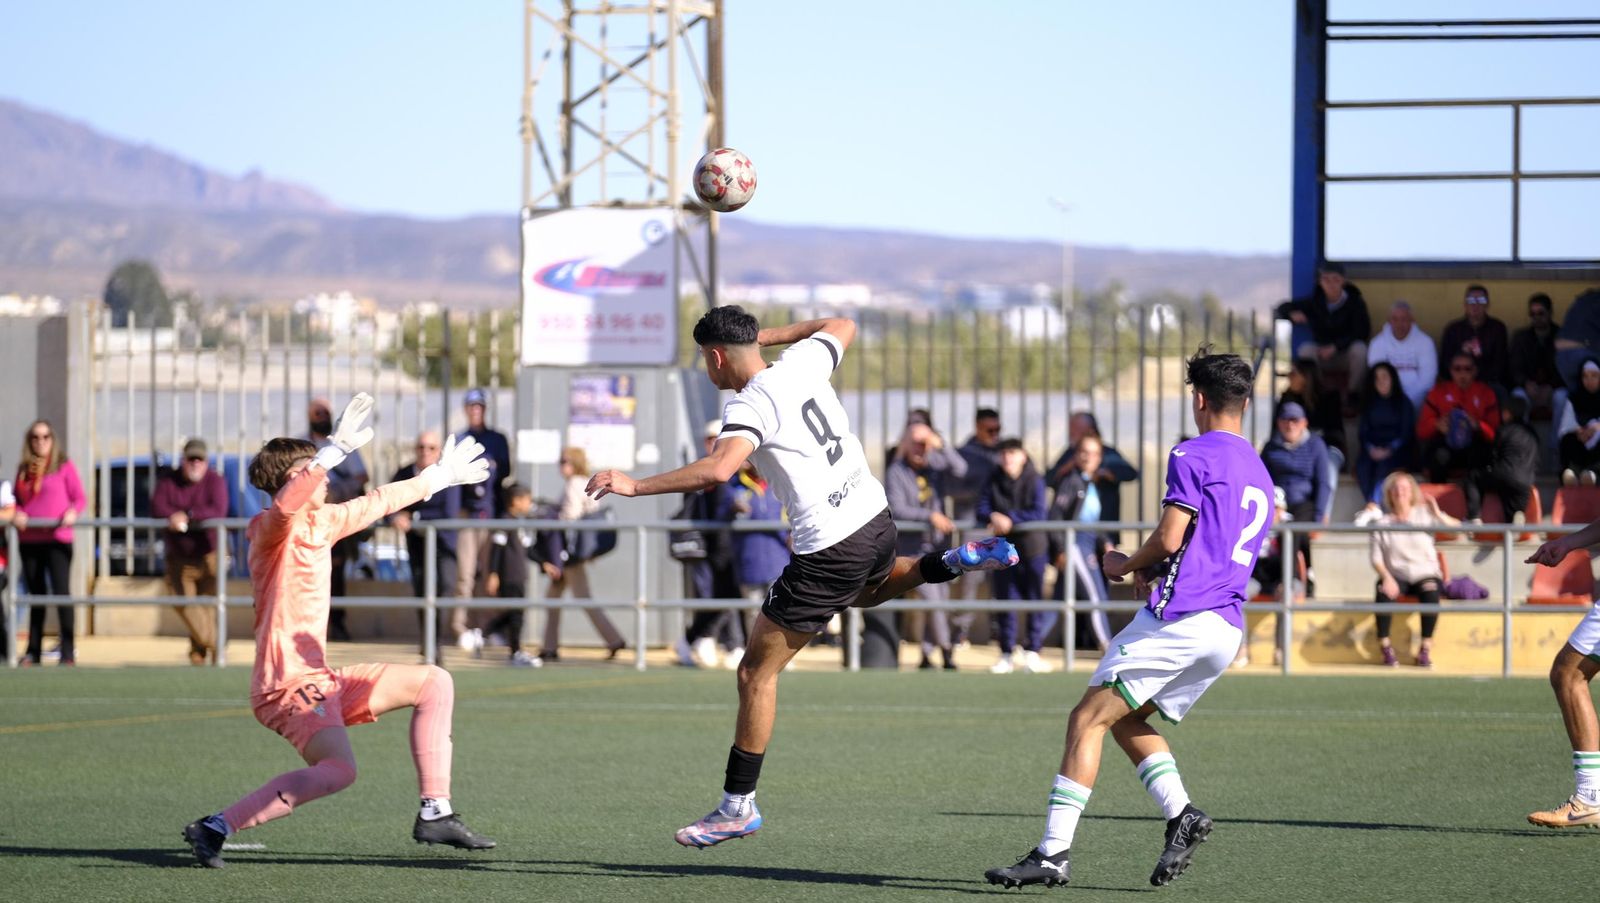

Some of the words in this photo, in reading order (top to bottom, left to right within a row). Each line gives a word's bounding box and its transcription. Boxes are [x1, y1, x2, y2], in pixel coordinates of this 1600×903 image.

[801, 397, 844, 467] 9
[1230, 485, 1269, 568] 2
[293, 683, 327, 705] 13
